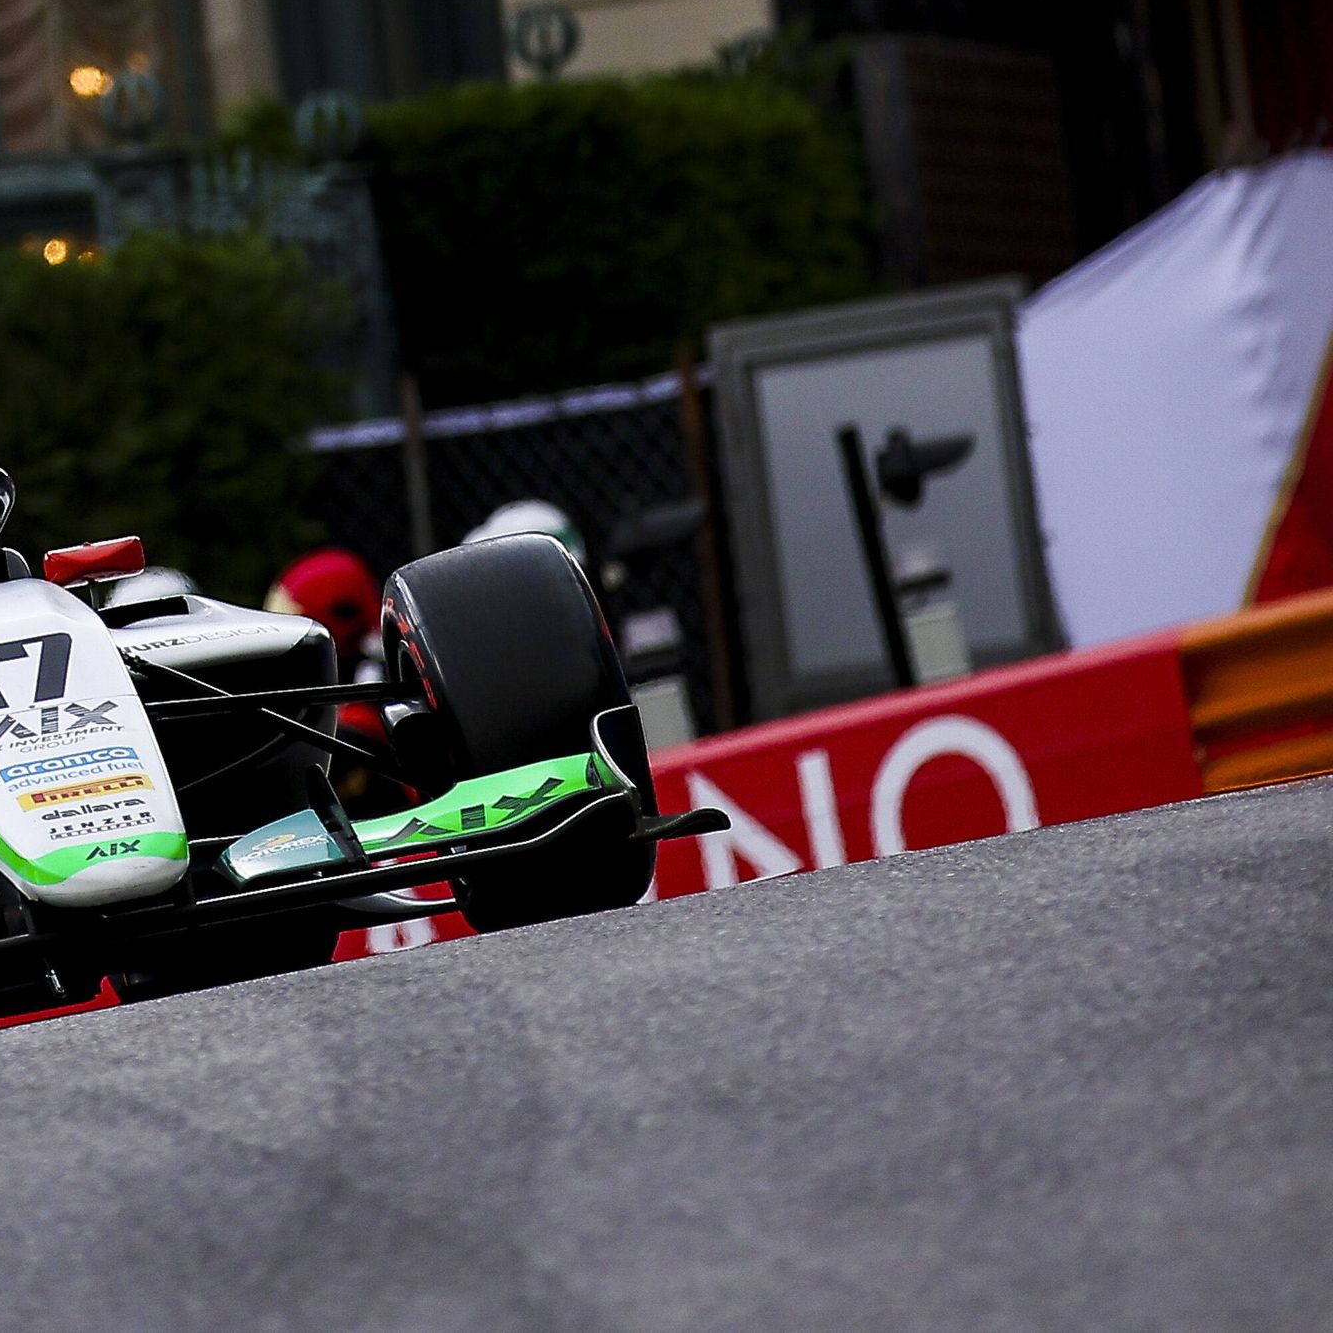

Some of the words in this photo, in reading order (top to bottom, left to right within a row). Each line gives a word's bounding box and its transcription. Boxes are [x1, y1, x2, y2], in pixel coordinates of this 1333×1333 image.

[9, 725, 125, 749] INVESTMENT
[20, 736, 86, 753] GROUP
[7, 748, 131, 777] aramco
[8, 765, 102, 793] advanced
[107, 761, 144, 772] fuel
[31, 776, 144, 804] PIRELLI
[41, 798, 146, 821] dallara
[381, 777, 564, 844] AIX
[49, 811, 152, 835] JENZER
[85, 839, 141, 861] AIX
